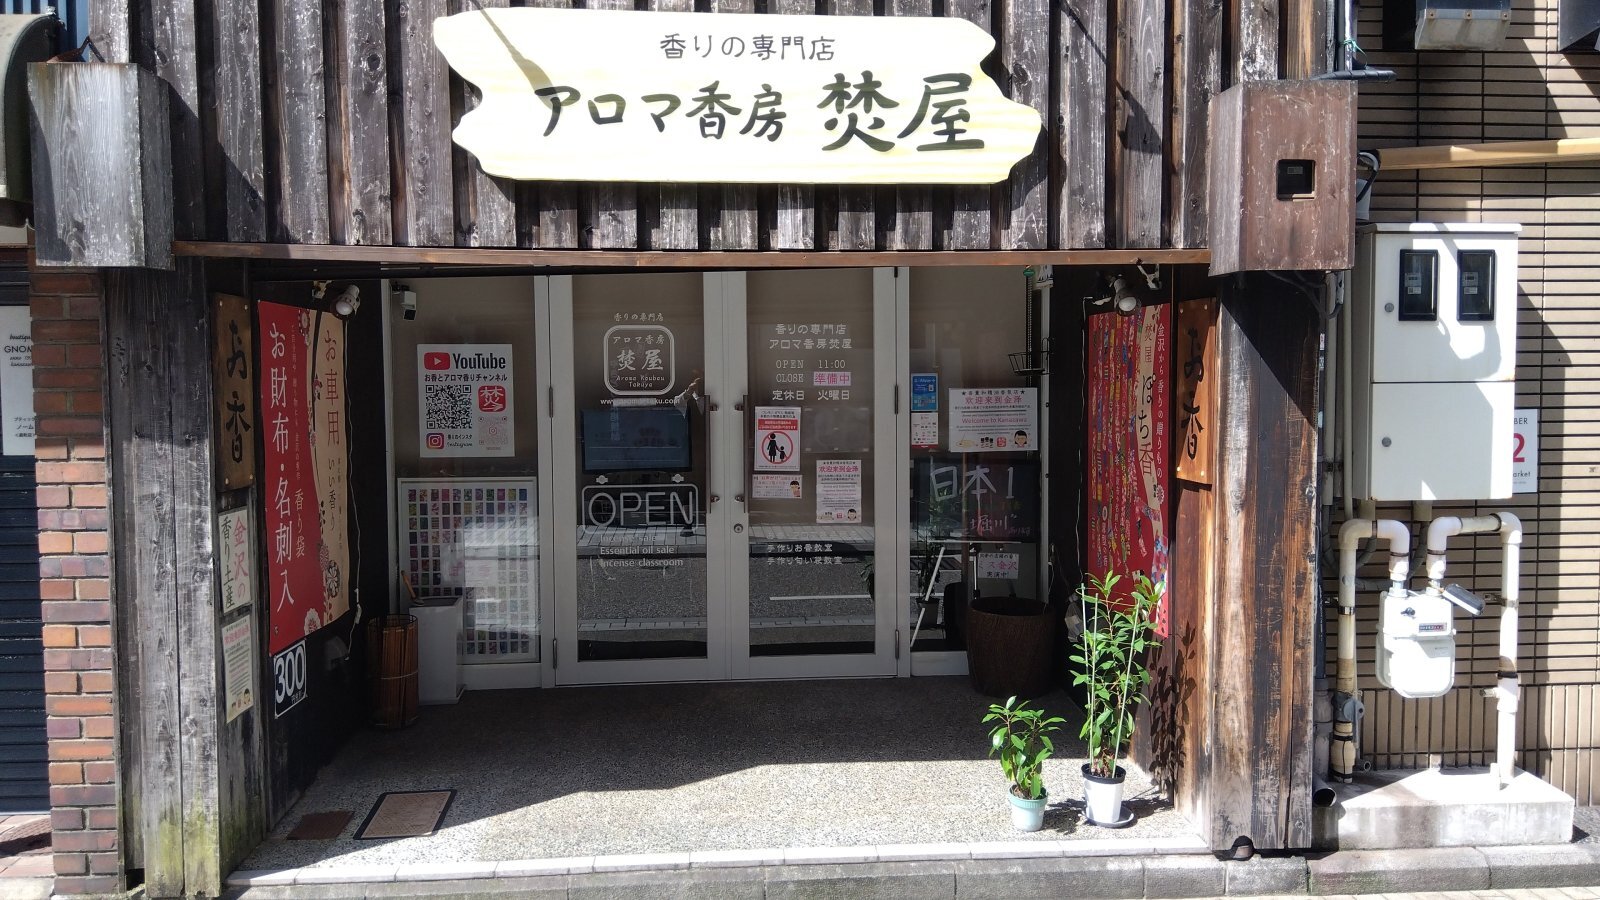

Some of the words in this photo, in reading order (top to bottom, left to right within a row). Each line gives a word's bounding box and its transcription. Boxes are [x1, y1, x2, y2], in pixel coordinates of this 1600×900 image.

[659, 33, 837, 61] 香りの専門店
[533, 80, 788, 142] アロマ香房
[817, 71, 986, 152] 焚屋
[614, 312, 664, 322] 香りの専門店
[775, 323, 847, 334] 香りの専門店
[612, 334, 665, 344] アロマ香房
[769, 338, 852, 349] アロマ香房焚屋
[1156, 323, 1165, 375] 金沢から
[453, 353, 506, 369] YouTube
[617, 349, 663, 371] 焚屋
[776, 360, 804, 368] OPEN
[818, 360, 846, 368] 11:00
[776, 373, 804, 383] CLOSE
[814, 373, 850, 385] 準備中
[324, 330, 340, 446] お車用
[772, 390, 805, 400] 定休日
[817, 390, 850, 400] 火曜日
[1155, 380, 1165, 477] 香りの贈りもの
[1513, 433, 1525, 462] 2
[589, 491, 693, 527] OPEN
[600, 546, 640, 555] Essential
[642, 545, 654, 554] oil
[656, 545, 674, 554] sale
[767, 543, 833, 552] 手作りお香教室
[233, 516, 249, 600] 金沢の
[638, 557, 684, 567] classroom
[275, 646, 305, 703] 300
